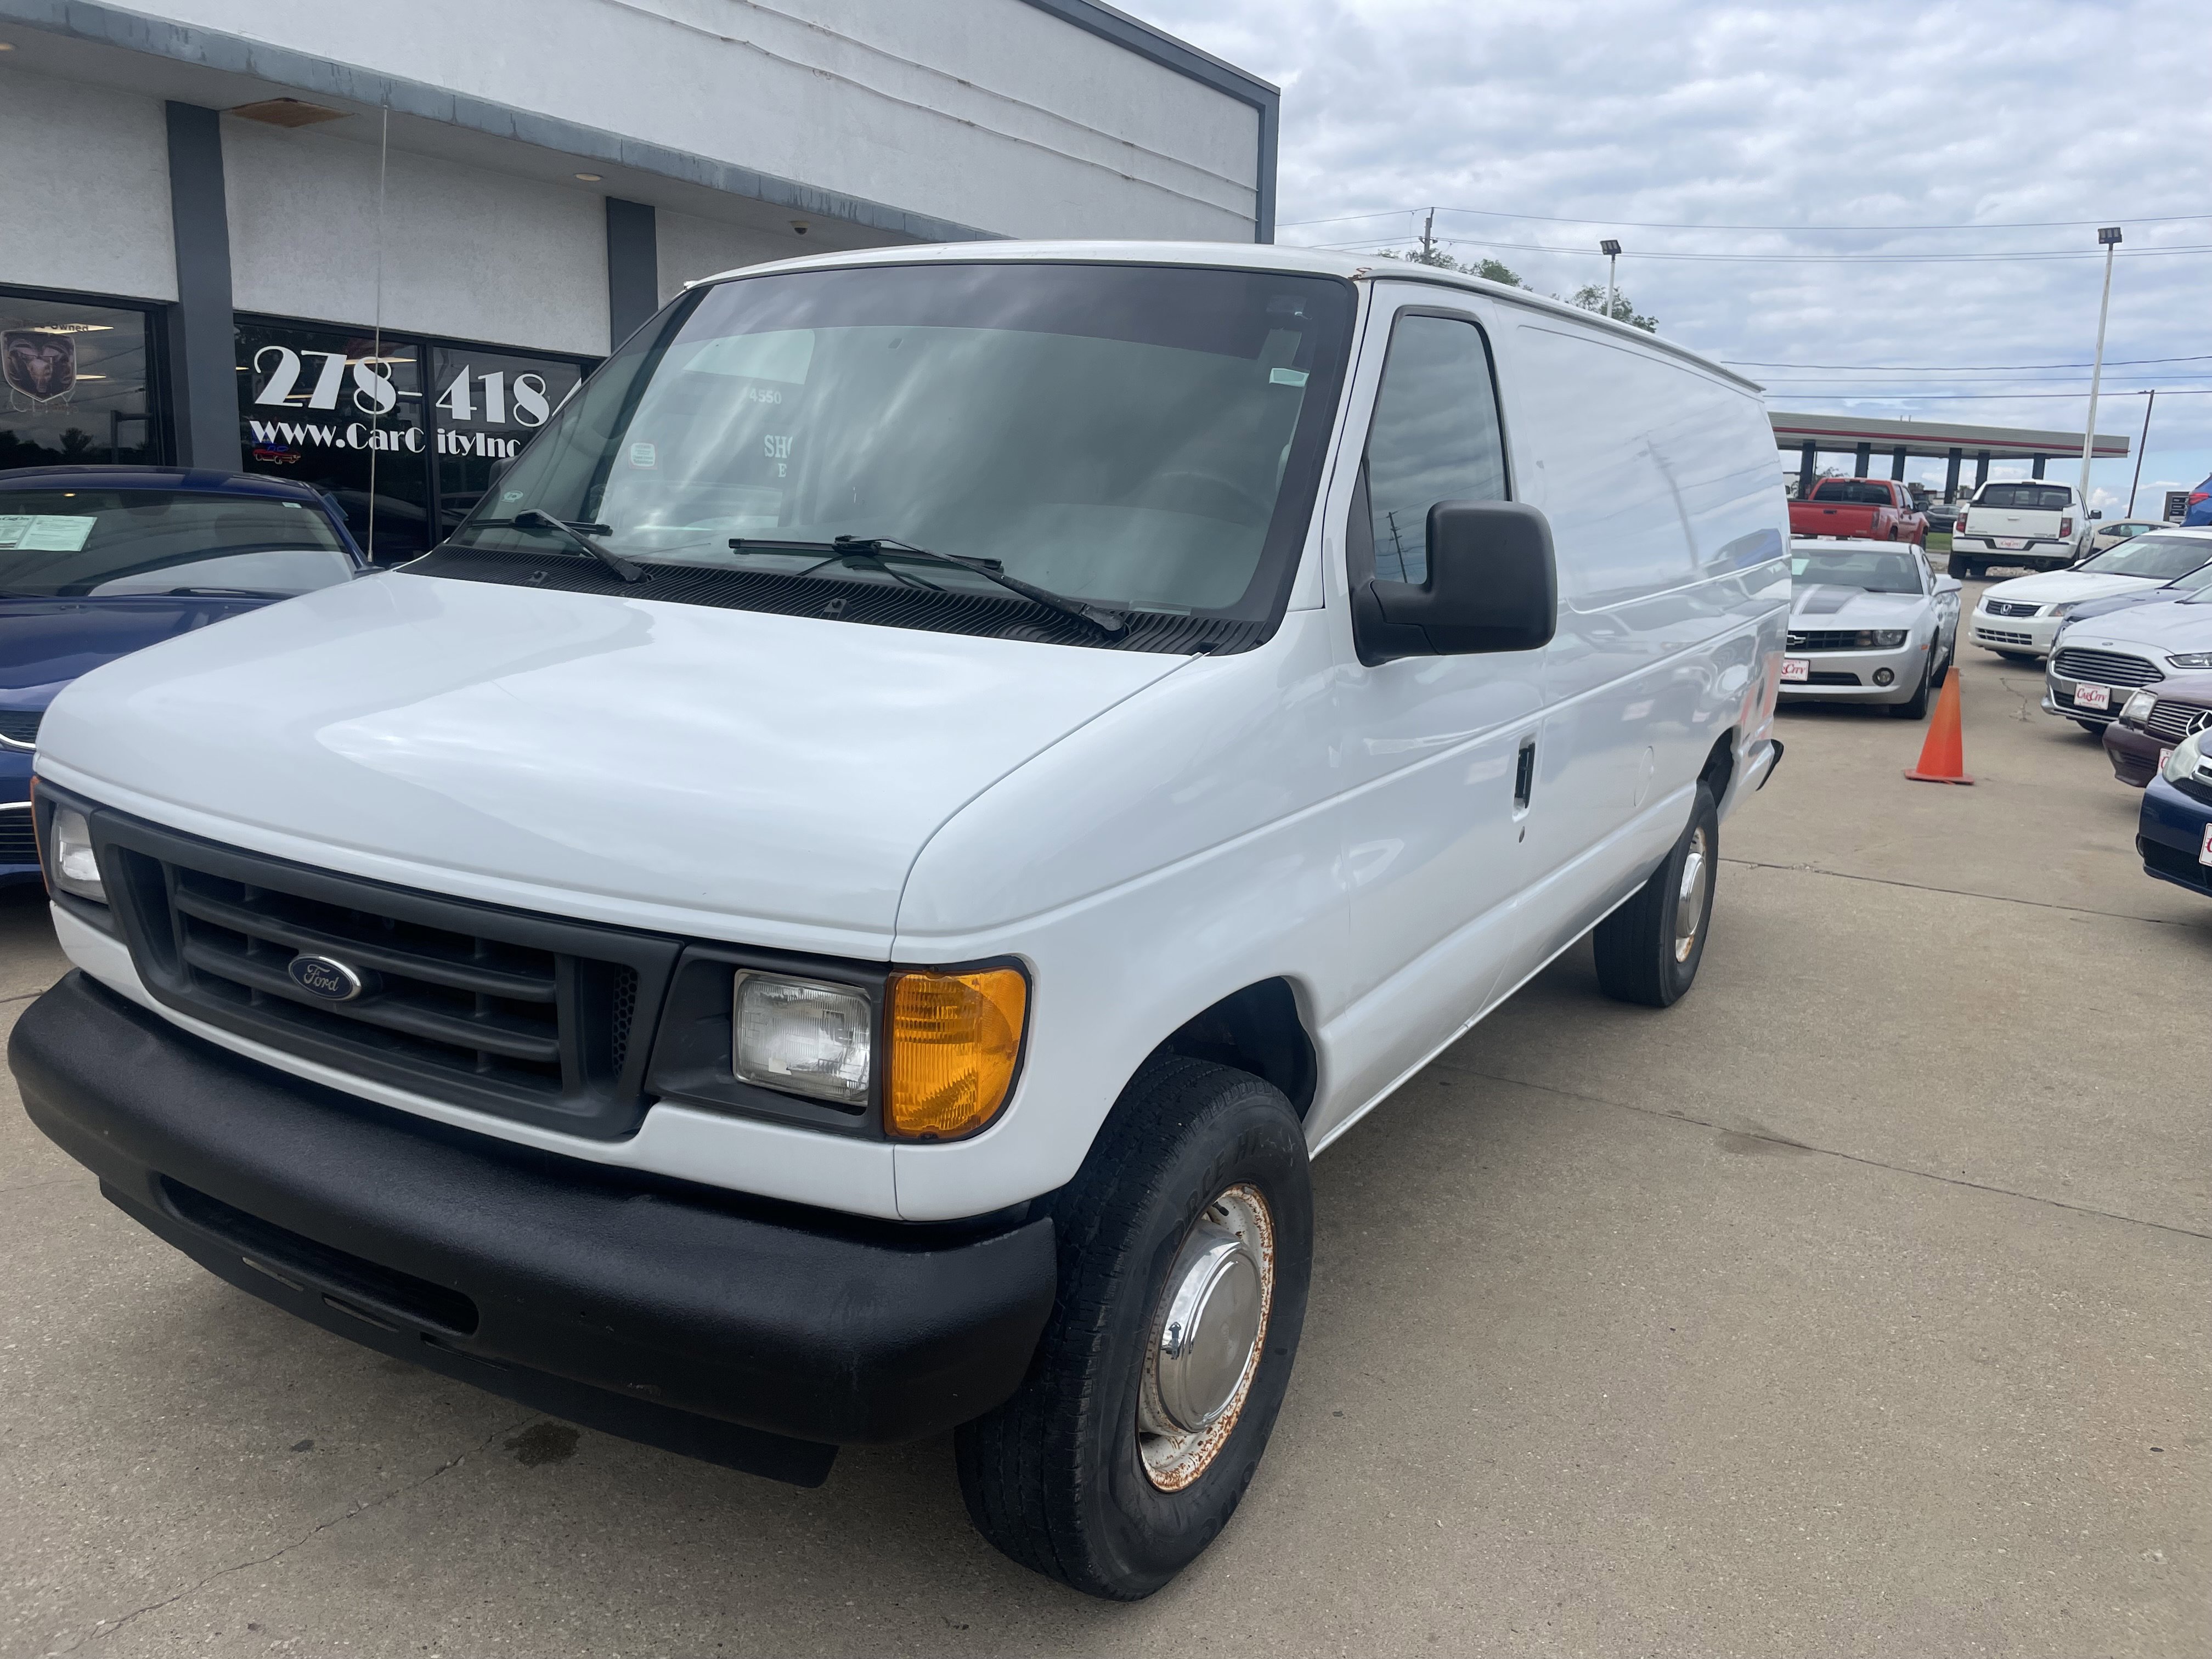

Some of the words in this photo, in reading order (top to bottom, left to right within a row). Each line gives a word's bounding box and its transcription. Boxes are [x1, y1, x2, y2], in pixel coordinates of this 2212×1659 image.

[254, 346, 582, 427] 278-418
[749, 388, 782, 404] 4550
[303, 964, 340, 991] Ford
